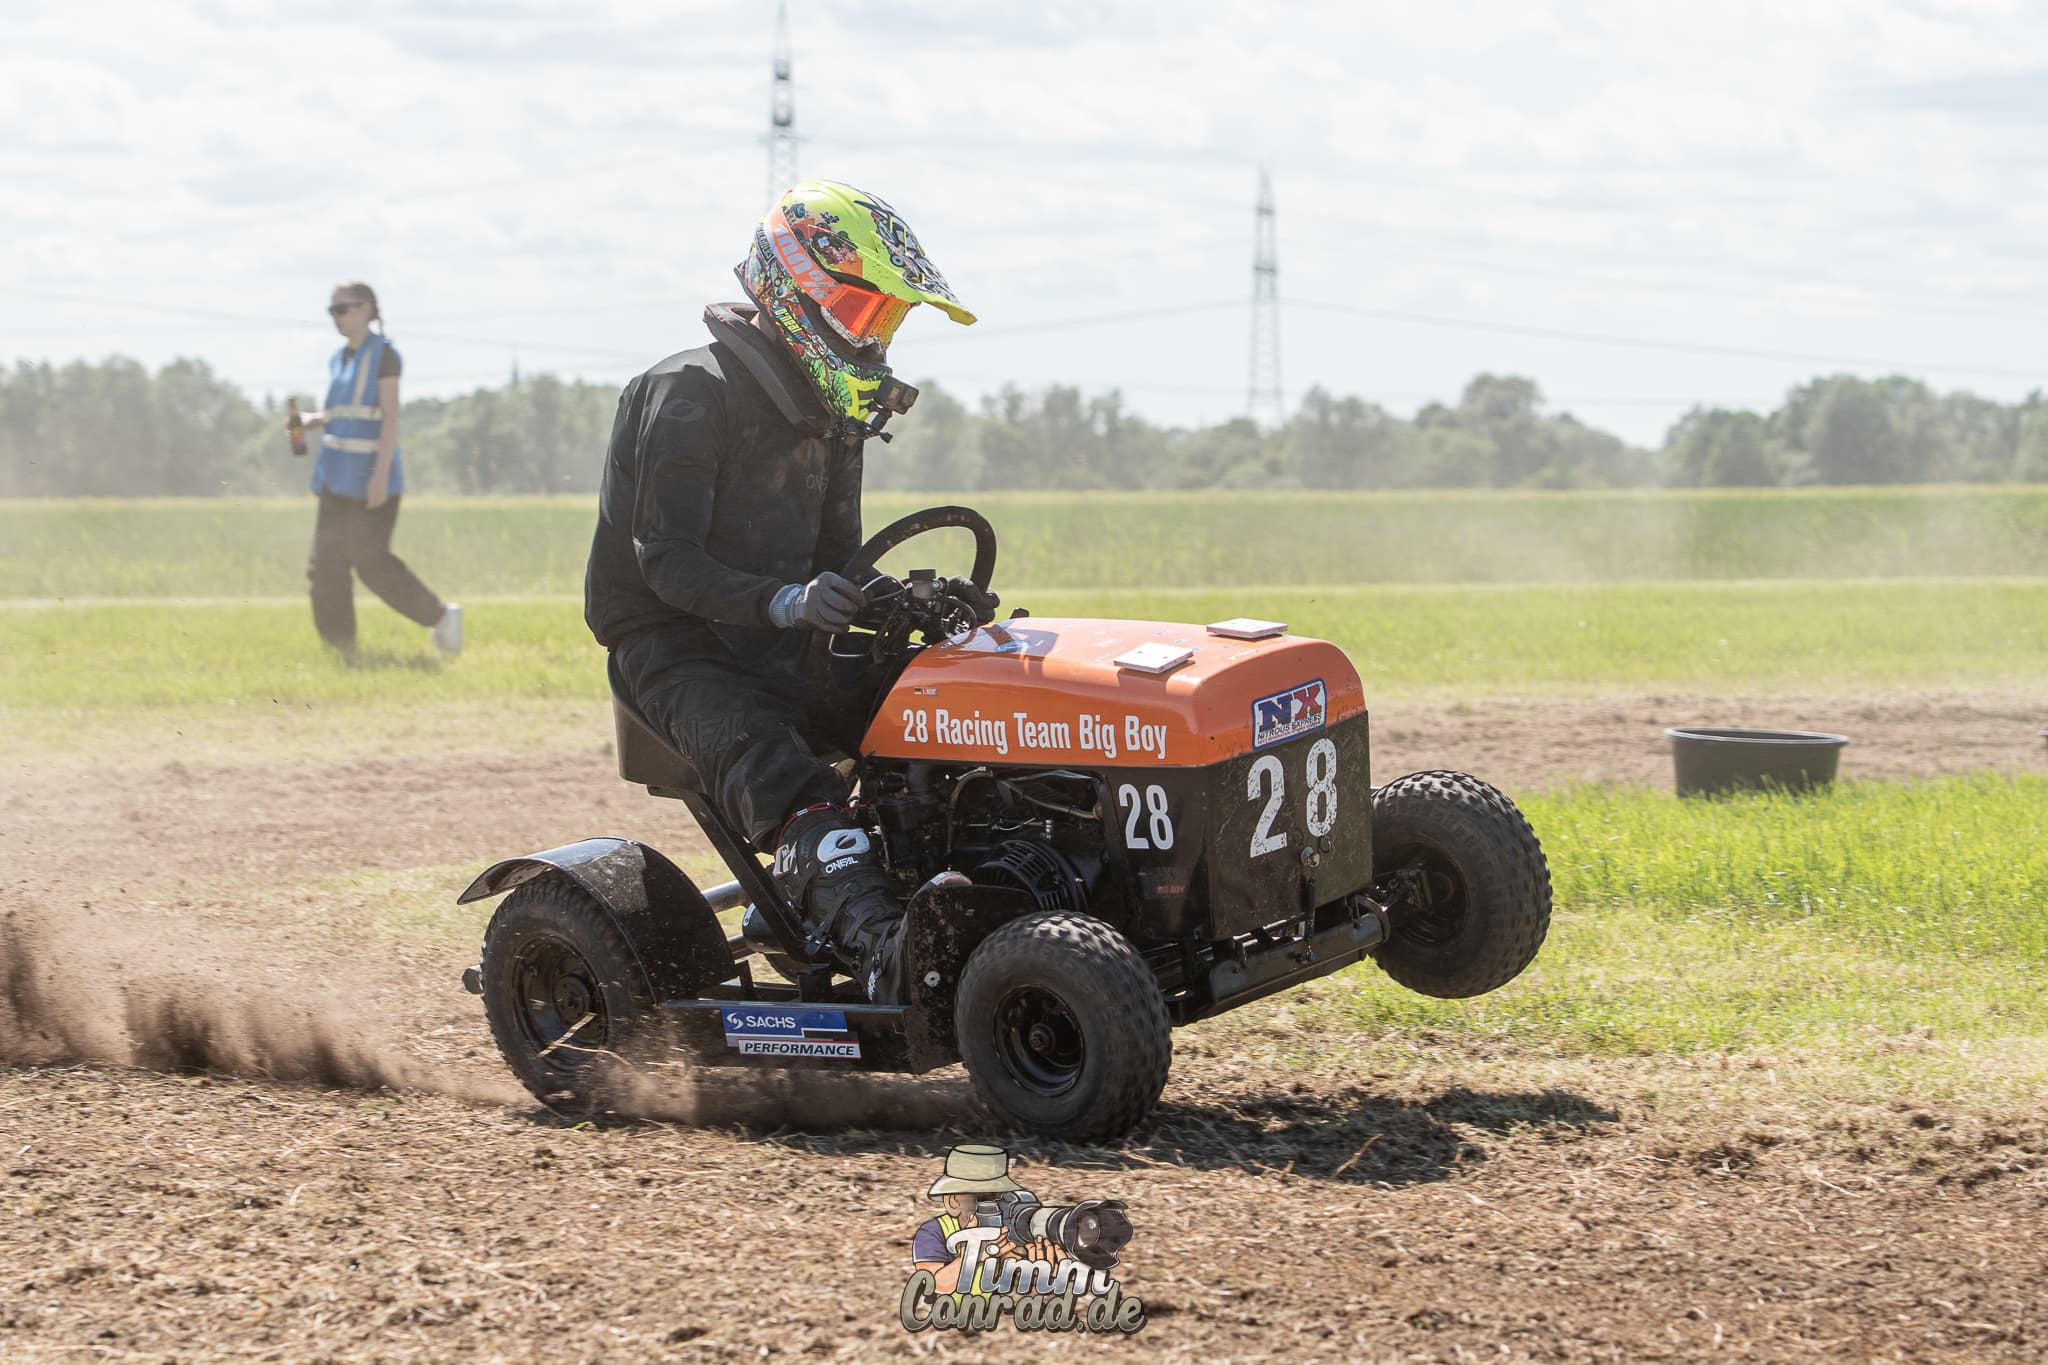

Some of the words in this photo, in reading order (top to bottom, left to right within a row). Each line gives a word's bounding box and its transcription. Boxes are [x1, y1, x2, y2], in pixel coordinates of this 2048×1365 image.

[1258, 684, 1322, 732] NX
[1258, 724, 1290, 741] NITROUS
[1291, 713, 1322, 729] EXPRESS
[902, 709, 928, 743] 28
[935, 709, 1008, 755] Racing
[1013, 712, 1071, 749] Team
[1079, 714, 1117, 759] Big
[1125, 715, 1167, 760] Boy
[1118, 783, 1174, 850] 28
[1248, 738, 1338, 858] 28
[745, 1015, 796, 1029] SACHS
[744, 1042, 855, 1056] PERFORMANCE
